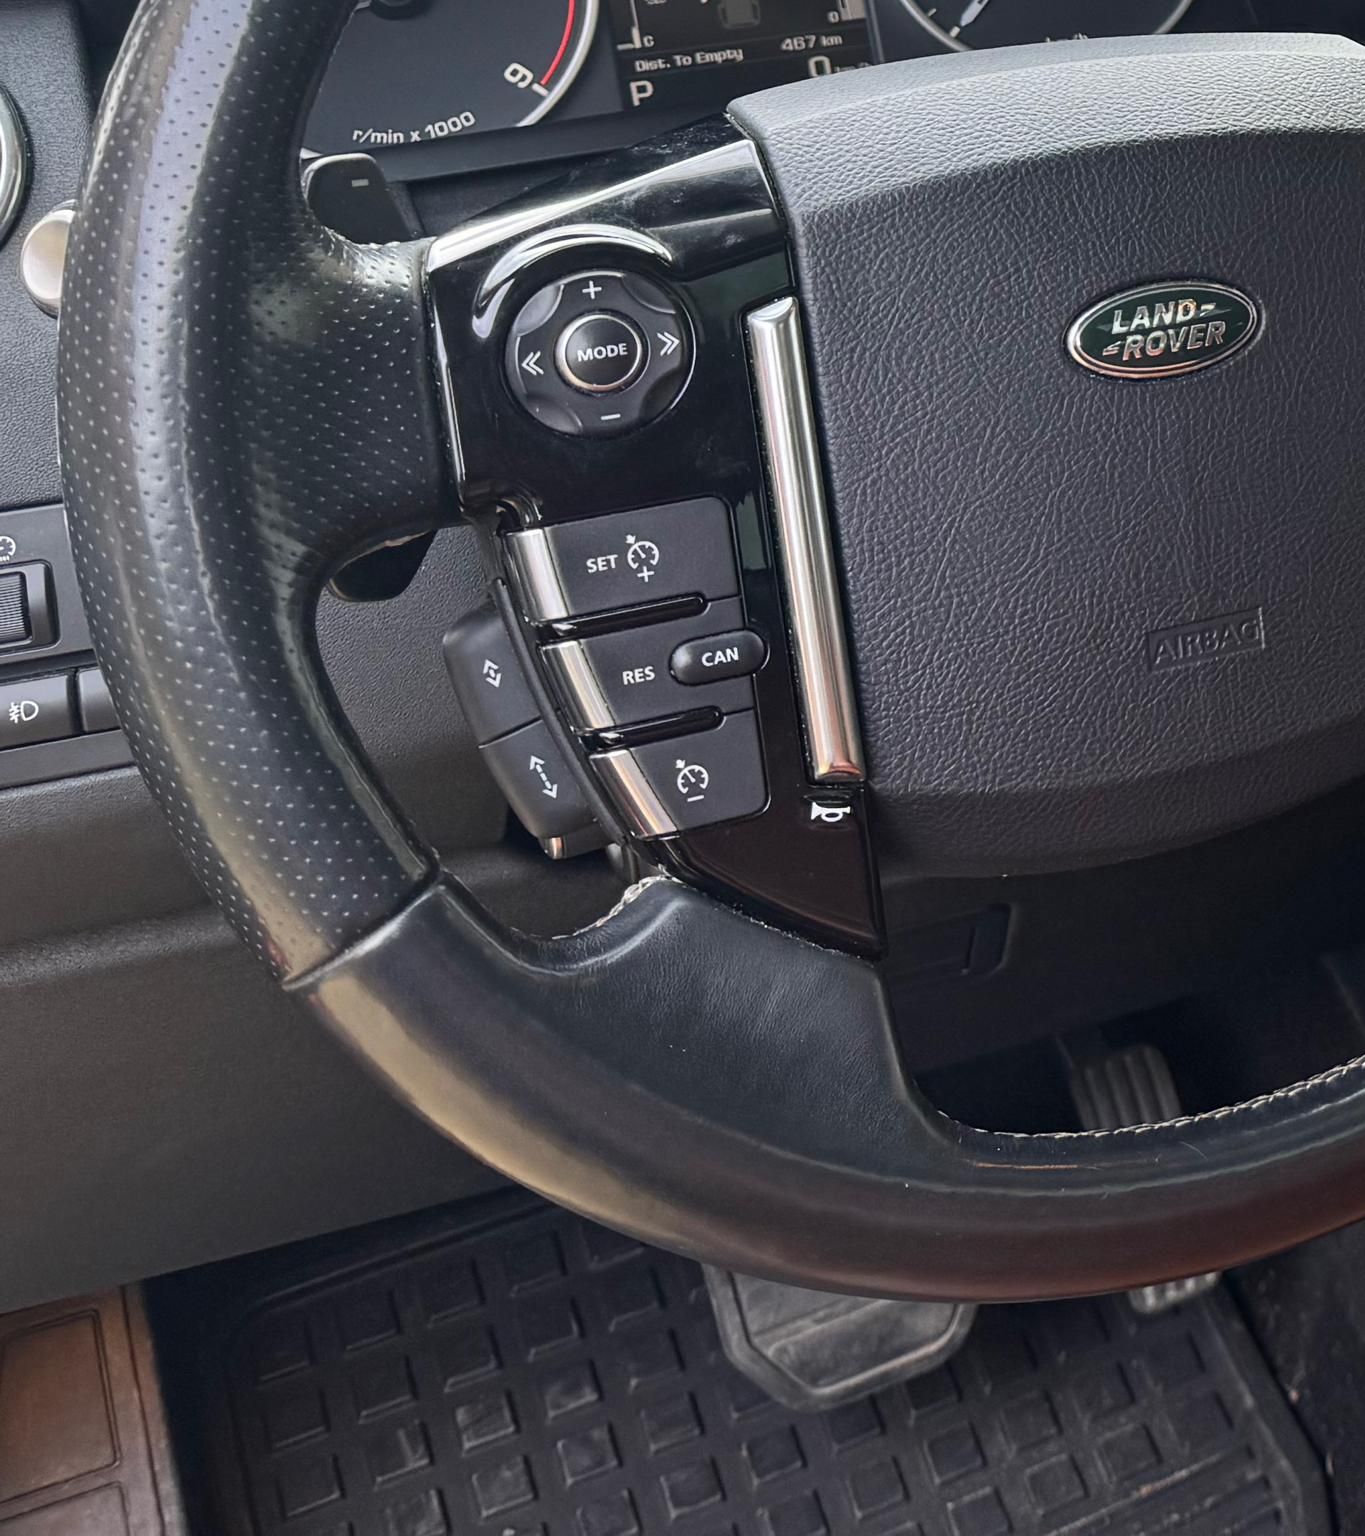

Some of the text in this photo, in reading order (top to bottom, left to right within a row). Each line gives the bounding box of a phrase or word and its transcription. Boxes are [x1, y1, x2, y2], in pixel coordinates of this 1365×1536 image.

[827, 11, 839, 23] 0
[781, 34, 843, 51] 467 km
[635, 47, 744, 73] Dist. To Empty
[503, 62, 535, 89] 6
[629, 80, 654, 106] P
[352, 111, 476, 145] r/min x 1000
[576, 342, 629, 364] MODE
[1122, 320, 1226, 361] ROVER
[586, 554, 618, 574] SET
[1155, 618, 1260, 665] AIRBAG
[621, 646, 740, 686] RES CAN
